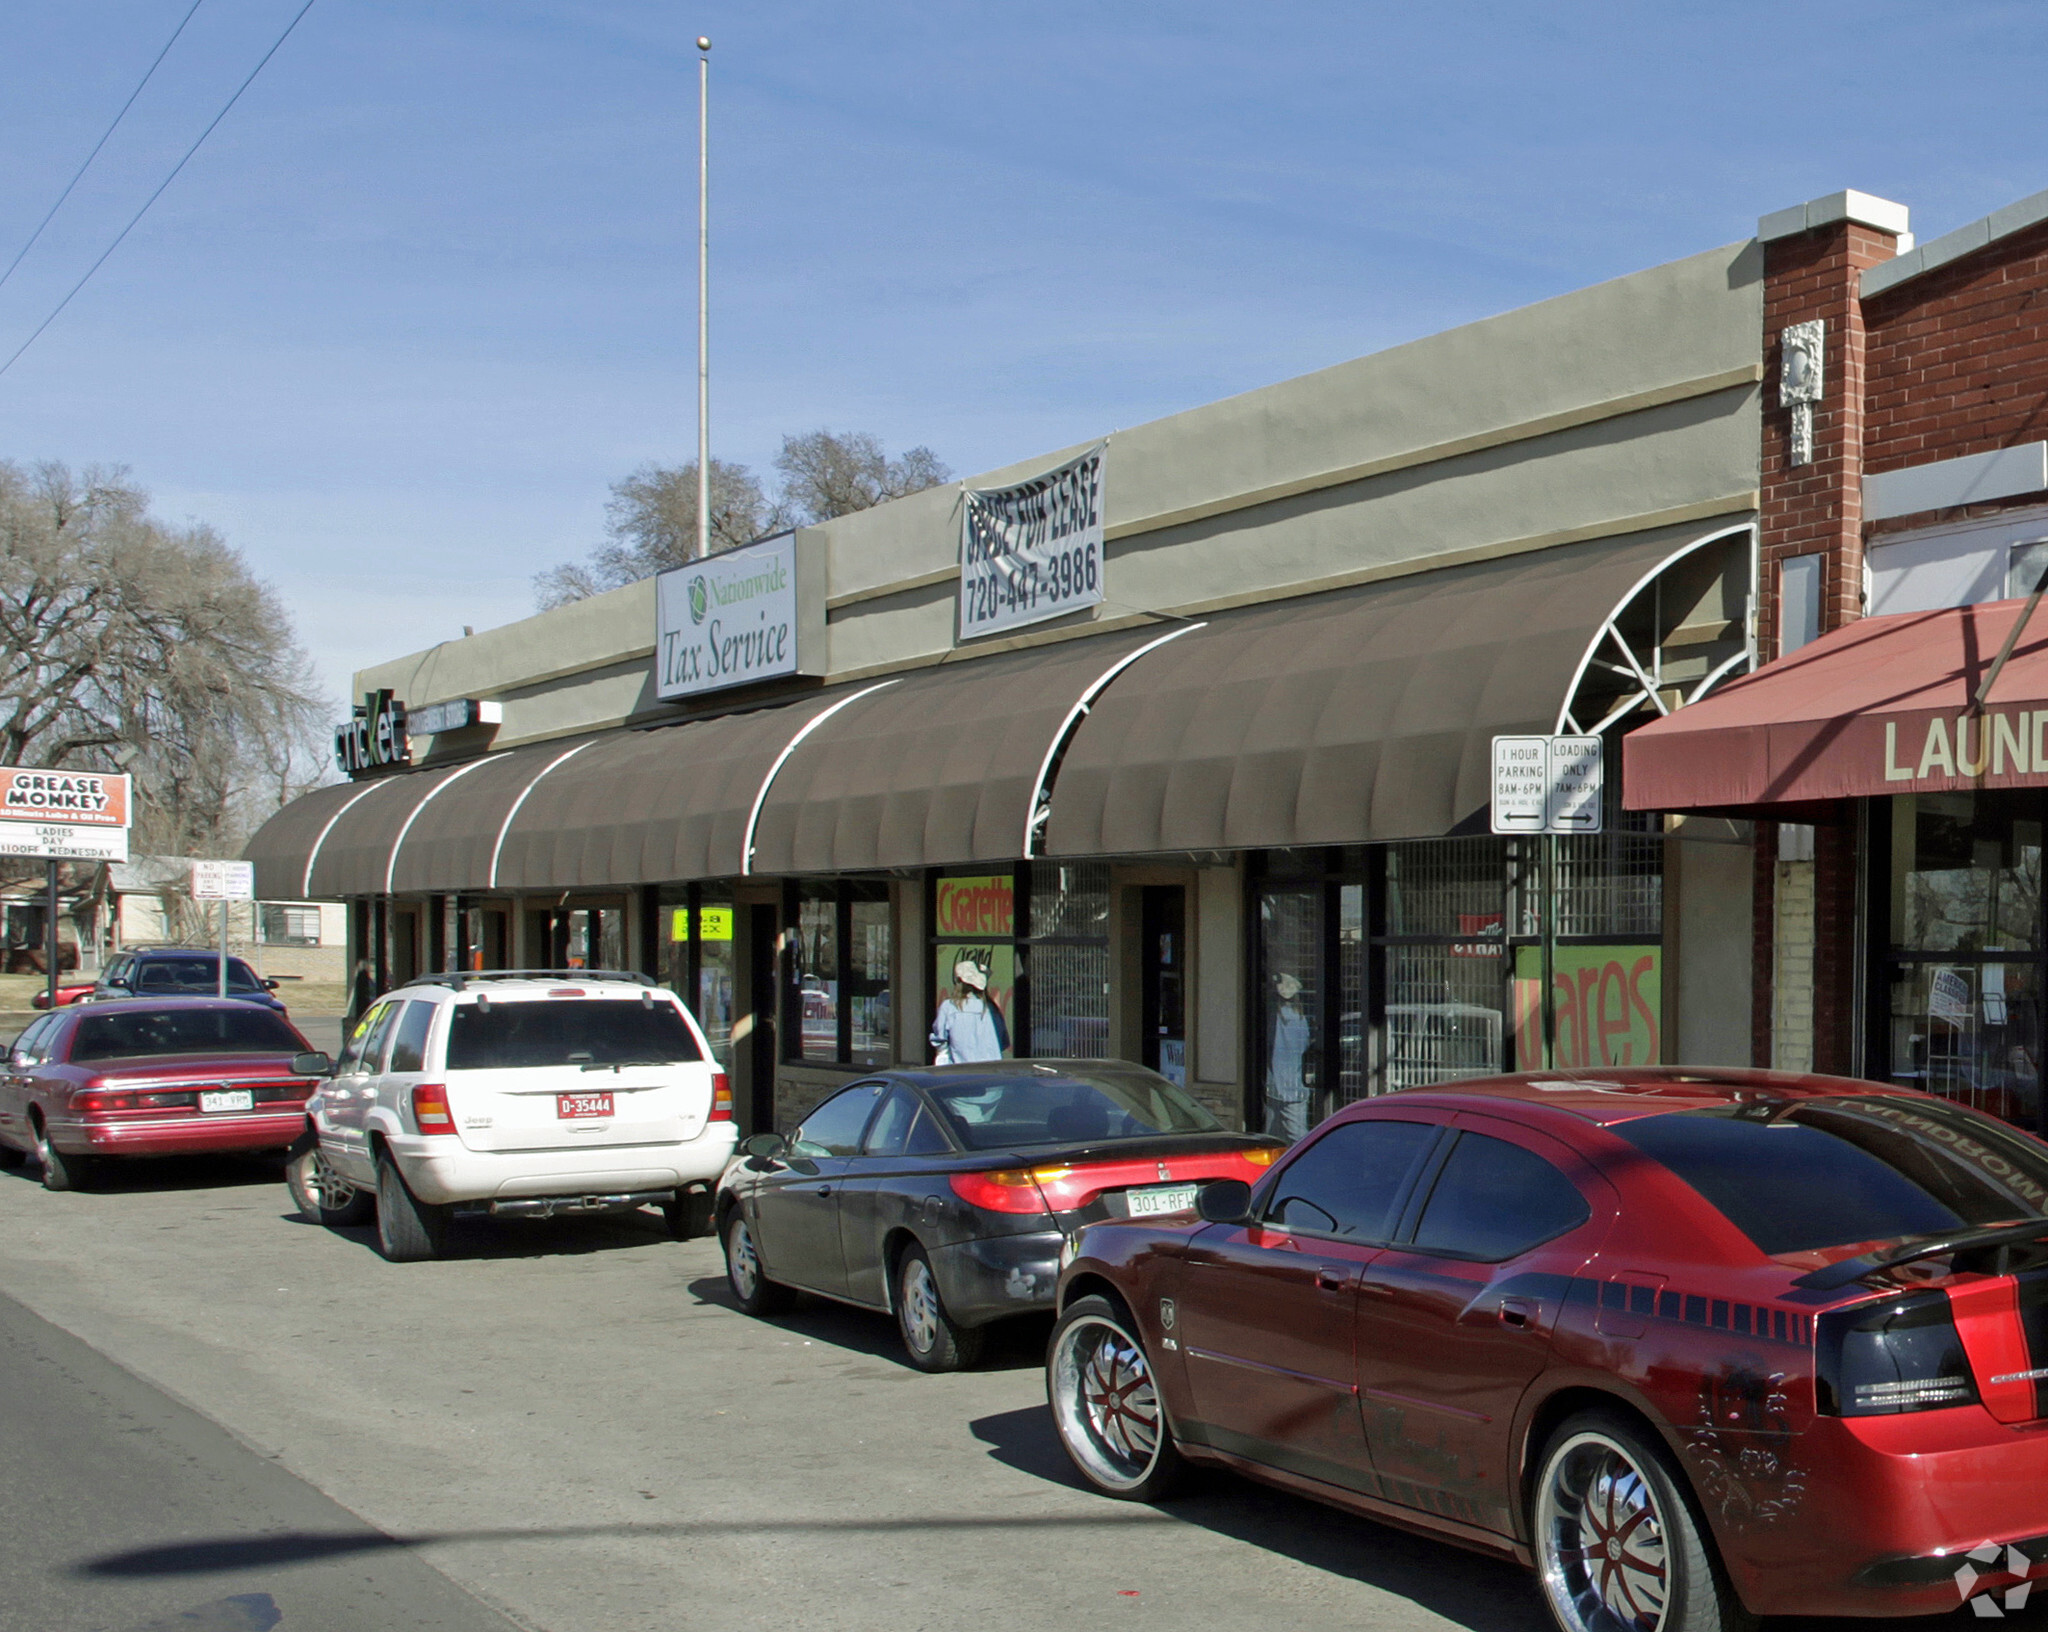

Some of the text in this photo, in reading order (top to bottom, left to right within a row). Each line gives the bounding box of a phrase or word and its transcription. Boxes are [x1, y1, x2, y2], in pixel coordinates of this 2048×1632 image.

[1051, 456, 1100, 541] LEASE
[709, 555, 788, 610] Nationwide
[966, 542, 1097, 624] 720-447-3986
[663, 610, 788, 687] Tax Service
[1510, 748, 1539, 761] HOUR
[1553, 744, 1598, 757] LOADING
[1498, 766, 1544, 778] PARKING
[1562, 764, 1589, 776] ONLY
[15, 775, 101, 794] GREASE
[1555, 782, 1597, 793] 7AM-6PM
[8, 790, 106, 809] MONKEY
[45, 811, 69, 819] Lube
[35, 828, 74, 837] LADIES
[42, 837, 64, 845] DAY
[938, 877, 1014, 934] Cigarette
[562, 1099, 611, 1113] D-35444
